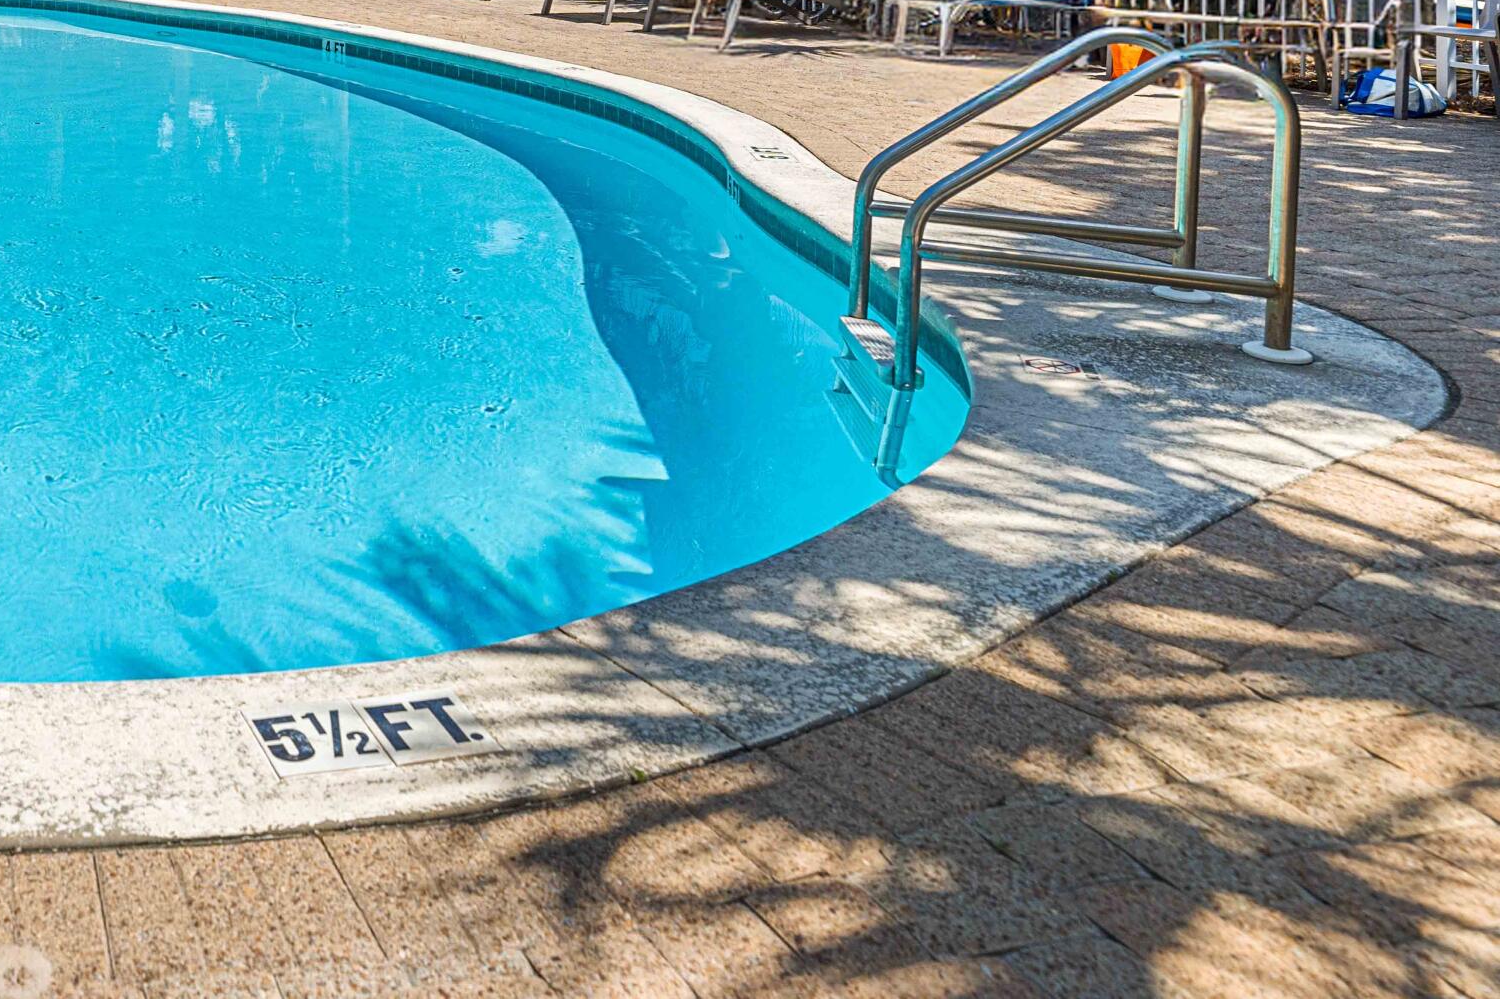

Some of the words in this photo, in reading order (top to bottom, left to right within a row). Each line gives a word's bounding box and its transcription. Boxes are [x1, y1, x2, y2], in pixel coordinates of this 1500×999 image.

[325, 40, 331, 52] 4
[334, 42, 345, 54] FT
[363, 697, 485, 752] FT.
